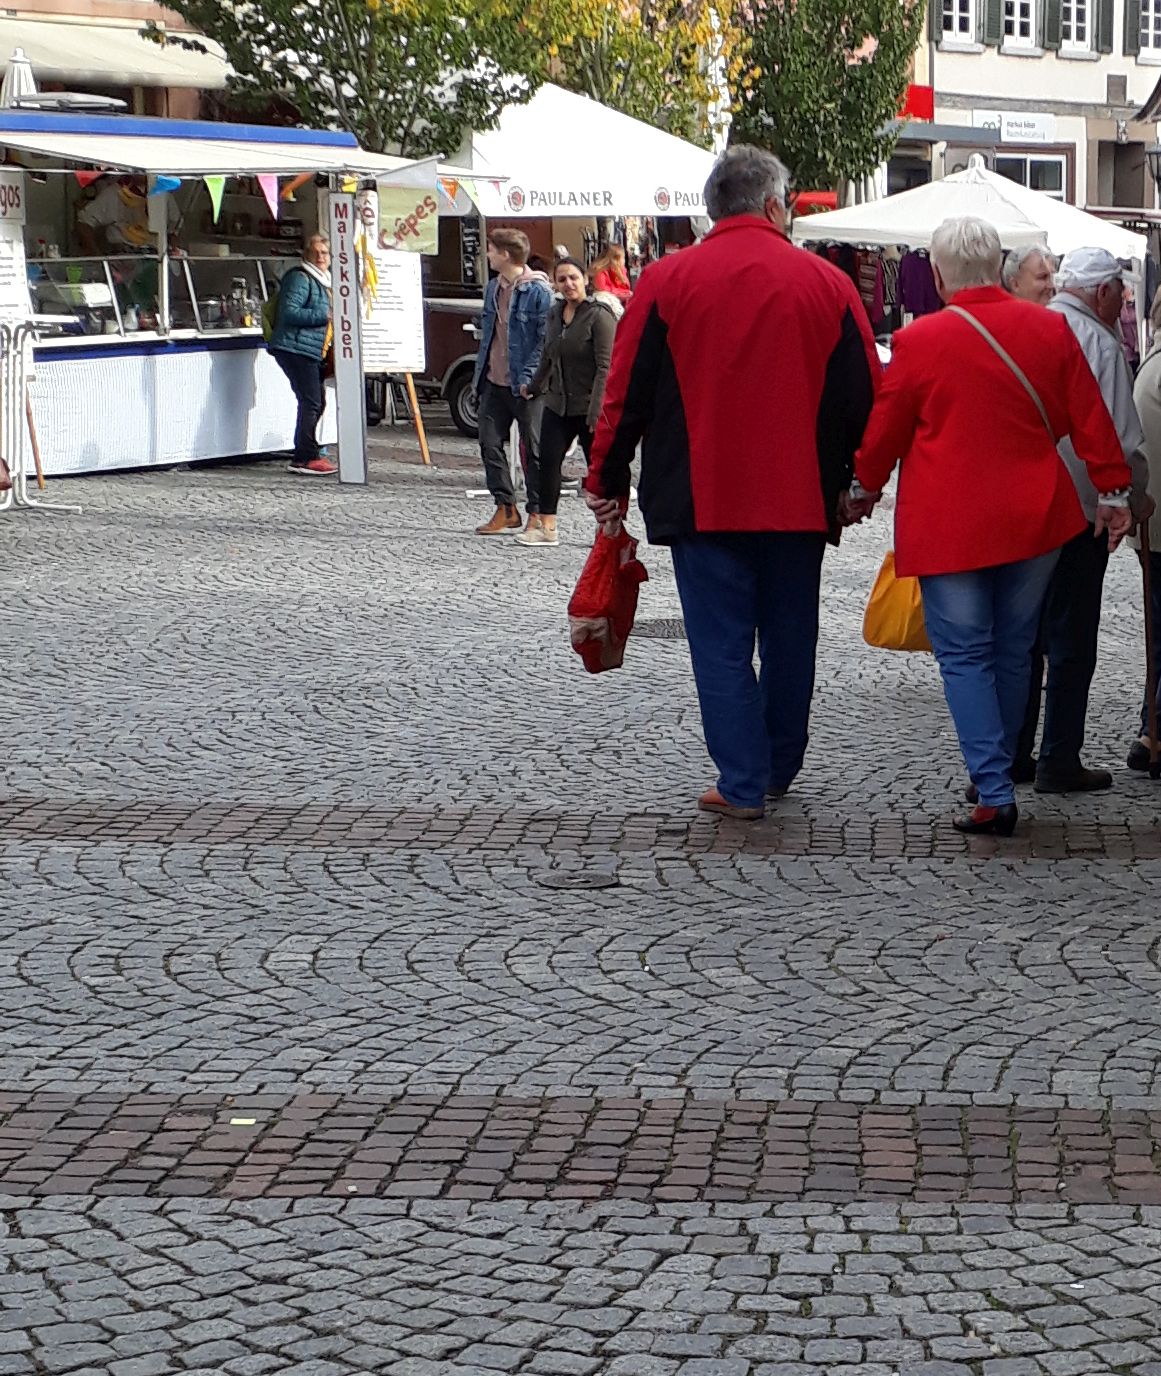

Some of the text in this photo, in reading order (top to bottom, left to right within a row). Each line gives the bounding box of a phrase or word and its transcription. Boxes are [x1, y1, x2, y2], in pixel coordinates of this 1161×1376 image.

[377, 194, 438, 250] Crêpes
[530, 190, 614, 207] PAULANER
[334, 202, 353, 359] Maiskolben
